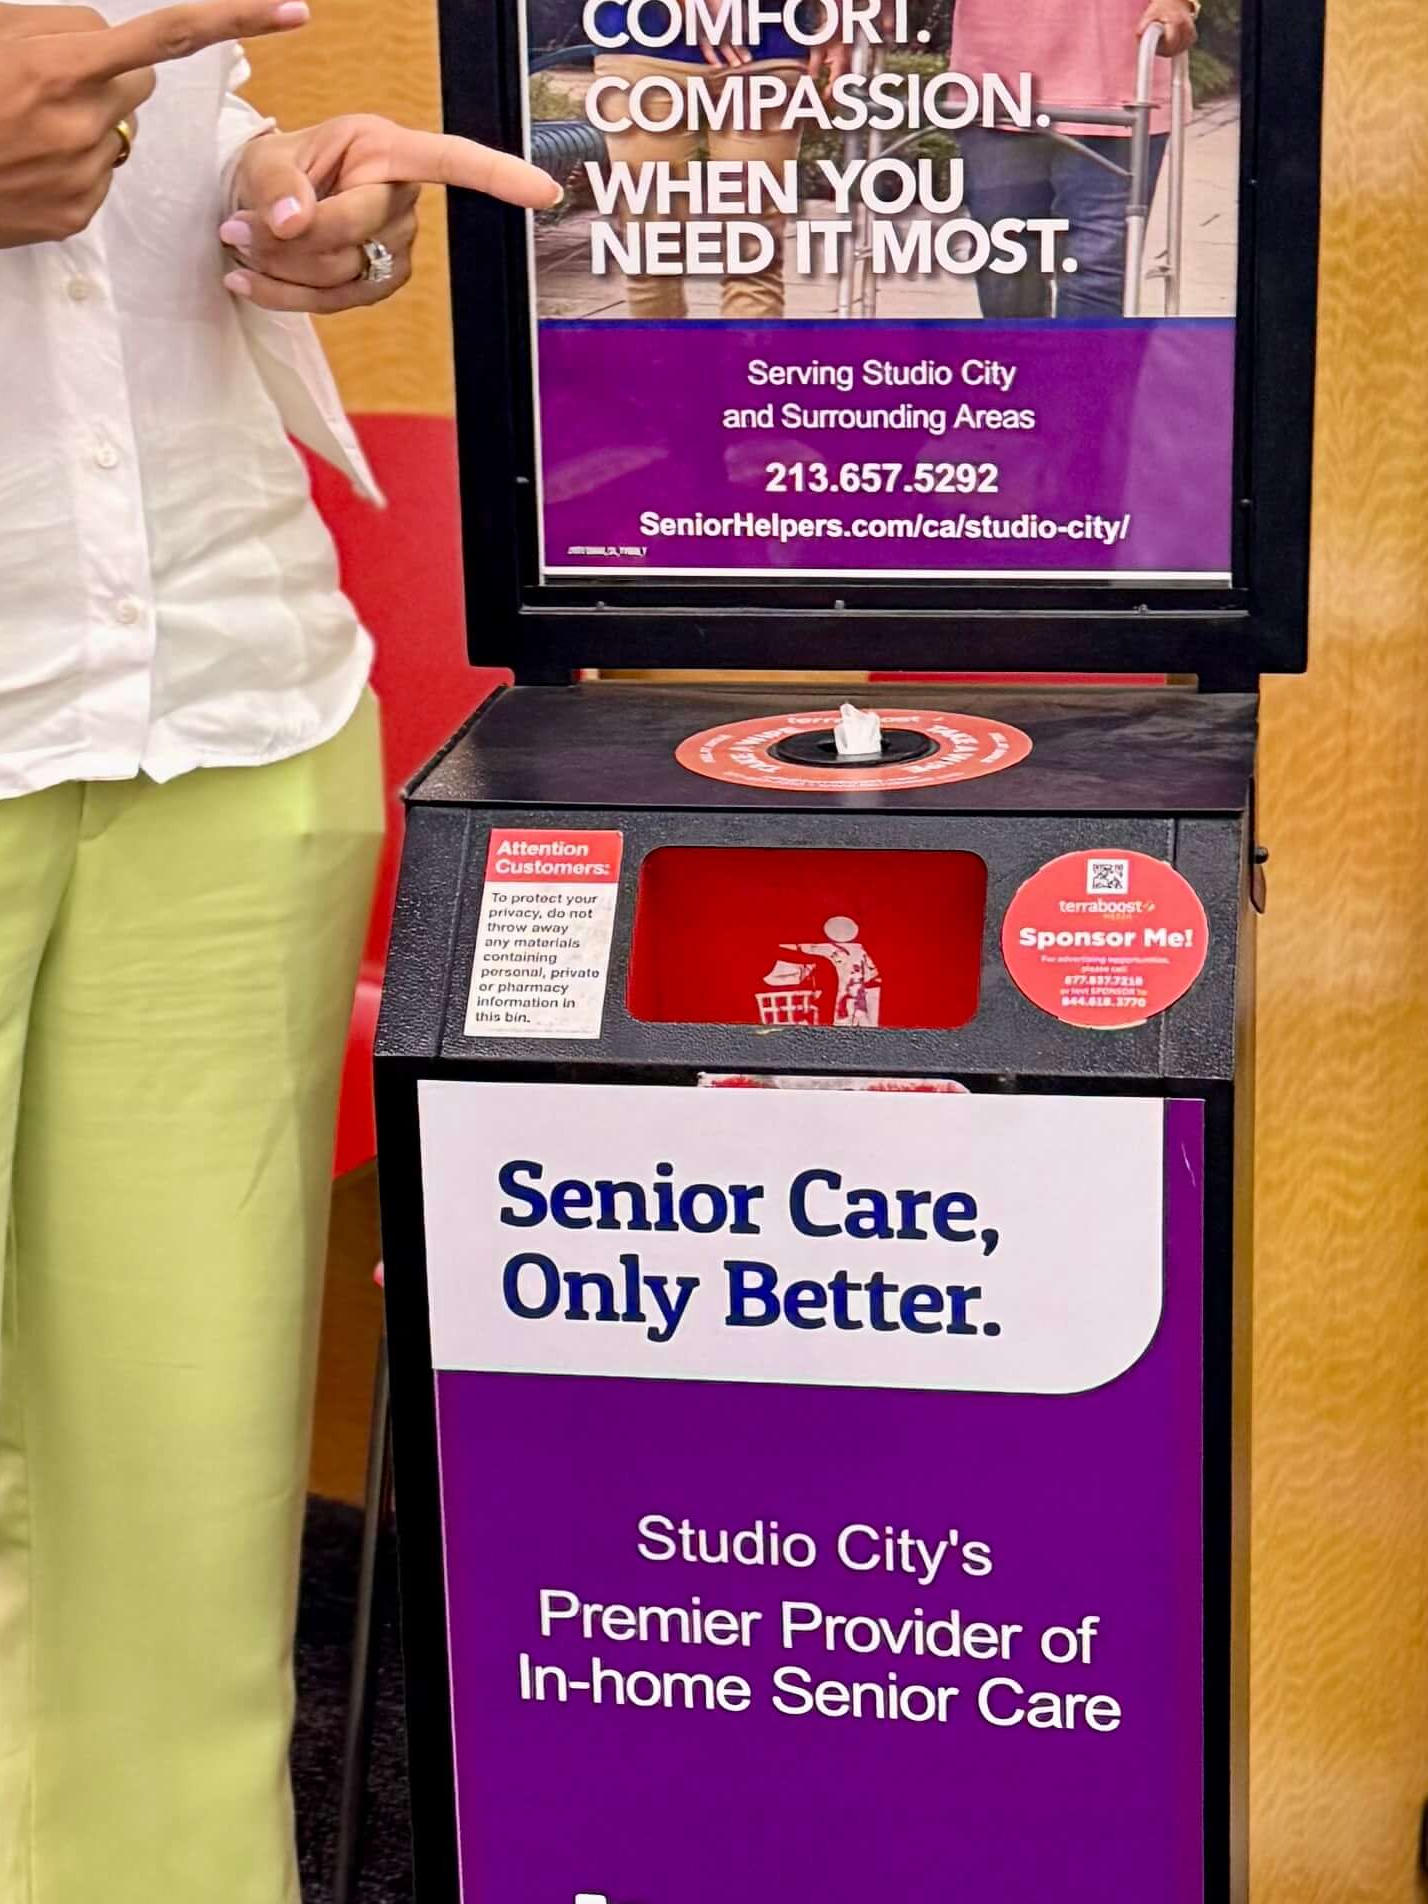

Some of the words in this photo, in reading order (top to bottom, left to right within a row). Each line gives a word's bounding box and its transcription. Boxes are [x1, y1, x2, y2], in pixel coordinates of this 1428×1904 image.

[585, 72, 1050, 134] COMPASSION.
[586, 160, 798, 215] WHEN
[820, 158, 963, 214] YOU
[592, 220, 774, 275] NEED
[798, 221, 850, 273] IT
[872, 219, 1078, 274] MOST.
[748, 359, 853, 392] Serving
[863, 358, 952, 387] Studio
[961, 358, 1017, 391] City
[723, 404, 774, 430] and
[781, 403, 946, 435] Surrounding
[954, 404, 1034, 430] Areas
[766, 463, 999, 494] 213.657.5292
[640, 512, 1130, 543] SeniorHelpers.com/ca/studio-city/
[497, 841, 588, 856] Attention
[495, 859, 609, 875] Customers:
[492, 893, 506, 904] To
[511, 894, 561, 904] protect
[566, 895, 597, 905] your
[1059, 899, 1142, 912] terraboost
[488, 909, 542, 920] privacy,
[547, 909, 565, 918] do
[570, 909, 592, 918] not
[488, 923, 527, 932] throw
[532, 925, 568, 934] away
[1020, 928, 1136, 950] Sponsor
[1144, 929, 1193, 947] Me!
[486, 939, 509, 949] any
[515, 938, 580, 948] materials
[484, 953, 557, 964] containing
[481, 967, 546, 978] personal,
[551, 968, 599, 979] private
[479, 984, 492, 992] or
[498, 983, 569, 994] pharmacy
[477, 997, 558, 1008] information
[563, 998, 575, 1008] in
[476, 1012, 500, 1022] this
[505, 1012, 530, 1023] bin.
[499, 1160, 763, 1232] Senior
[789, 1168, 1001, 1257] Care,
[503, 1252, 699, 1342] Only
[725, 1261, 1001, 1337] Better.
[637, 1516, 816, 1569] Studio
[837, 1524, 992, 1585] City's
[539, 1590, 762, 1648] Premier
[782, 1602, 1023, 1660] Provider
[1041, 1615, 1099, 1664] of
[519, 1653, 751, 1712] In-home
[772, 1666, 958, 1723] Senior
[978, 1677, 1122, 1732] Care
